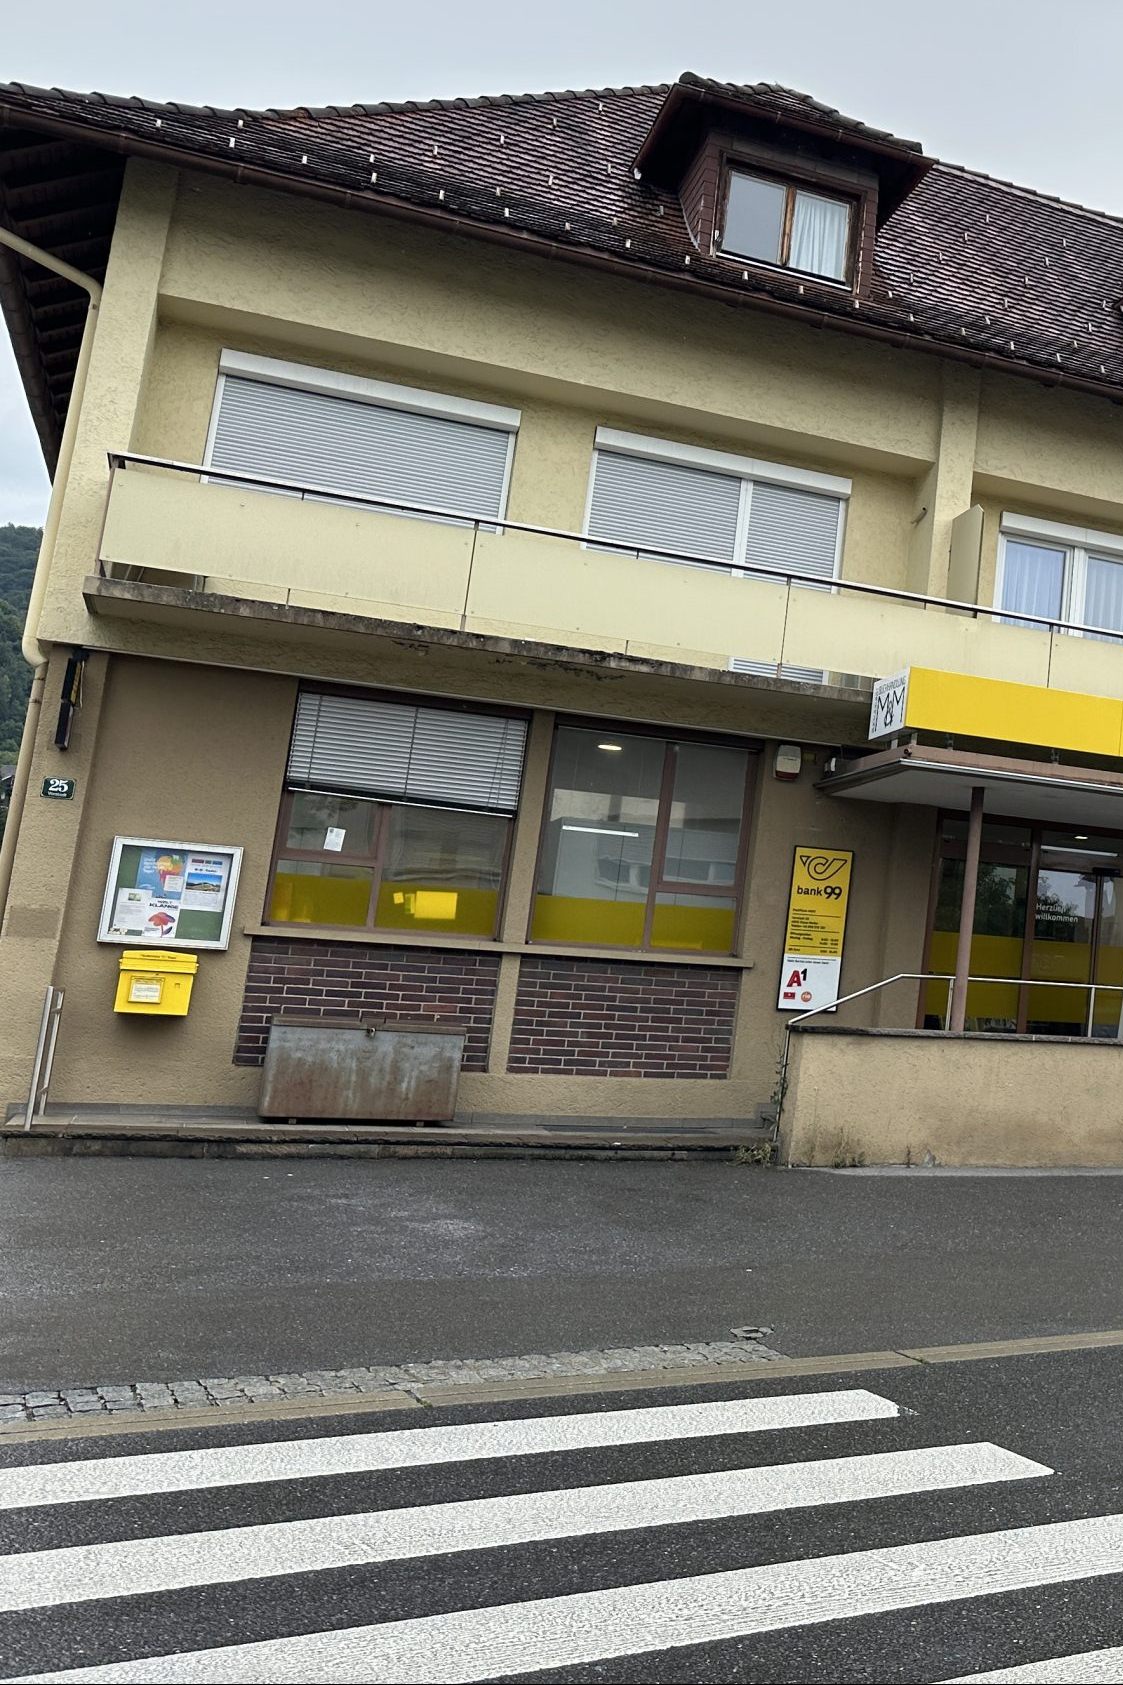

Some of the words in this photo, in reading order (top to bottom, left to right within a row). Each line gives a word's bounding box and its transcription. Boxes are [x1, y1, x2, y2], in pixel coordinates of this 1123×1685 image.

[48, 778, 69, 793] 25
[797, 885, 823, 896] bank
[823, 885, 843, 900] 99
[1035, 903, 1066, 913] Herzlich
[1035, 912, 1079, 923] willkommen
[787, 968, 808, 988] A1
